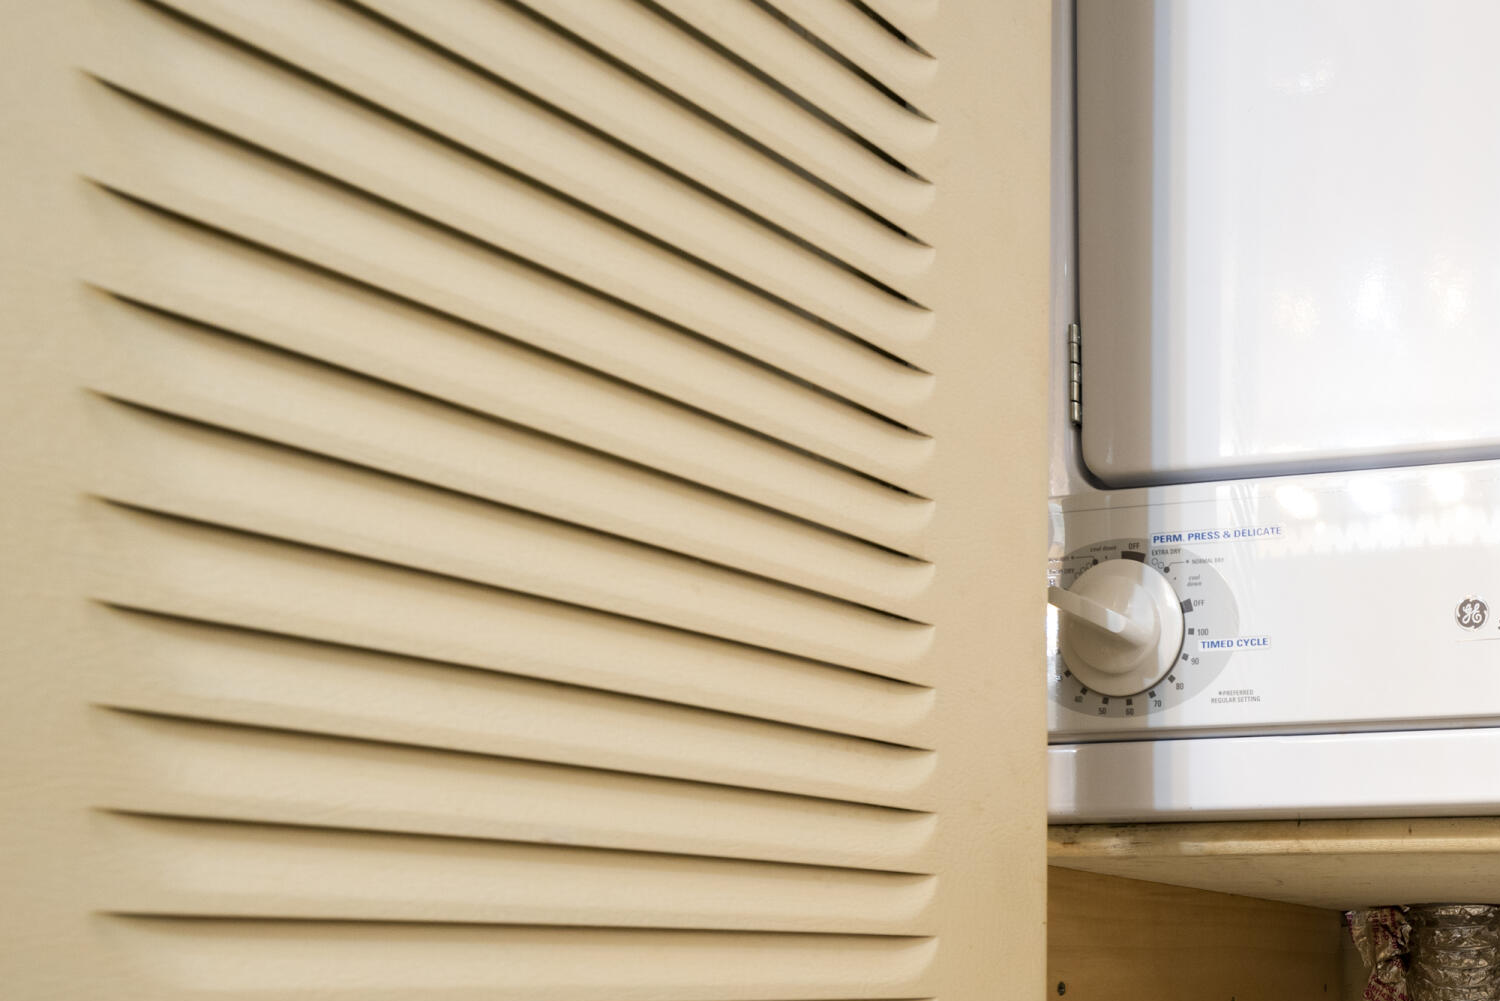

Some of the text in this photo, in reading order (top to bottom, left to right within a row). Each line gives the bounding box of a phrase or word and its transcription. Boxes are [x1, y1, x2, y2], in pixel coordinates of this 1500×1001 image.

[1153, 526, 1281, 544] PERM. PRESS & DELICATE
[1128, 542, 1140, 550] OFF
[1151, 549, 1169, 557] EXTRA
[1193, 599, 1205, 608] OFF
[1197, 628, 1209, 636] 100
[1201, 637, 1269, 649] TIMED CYCLE
[1238, 695, 1261, 703] SETTING
[1153, 699, 1162, 708] 70
